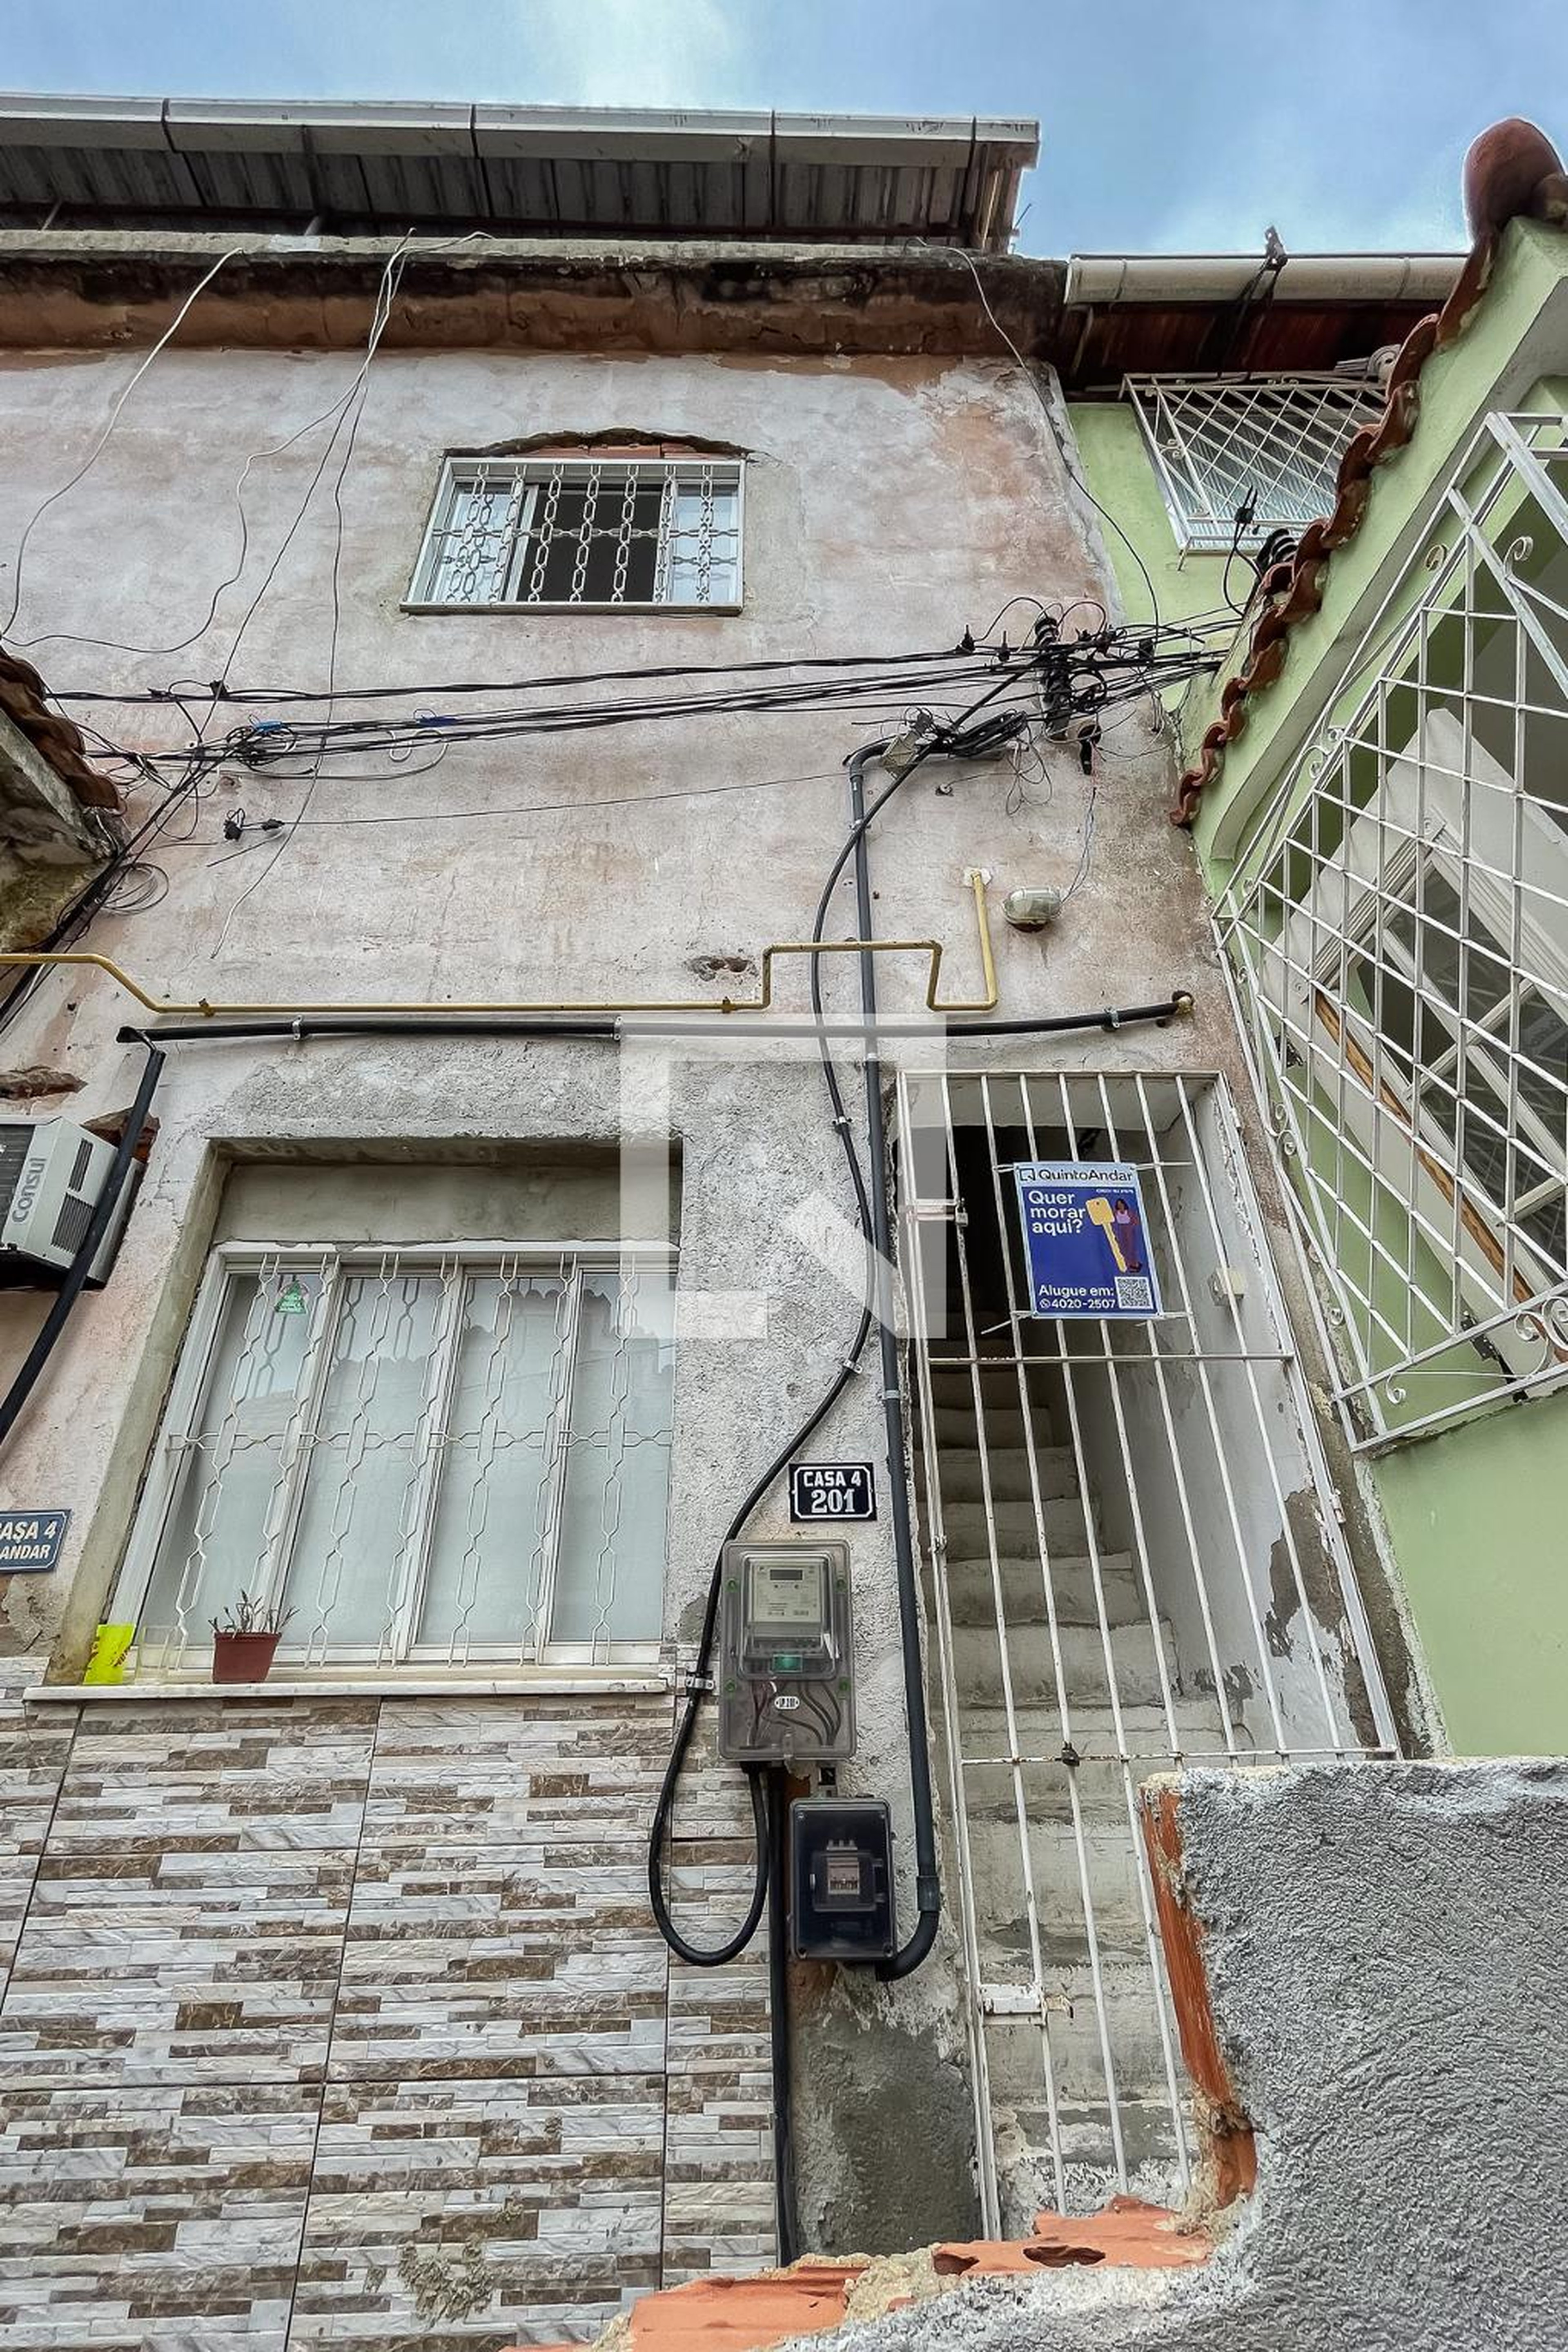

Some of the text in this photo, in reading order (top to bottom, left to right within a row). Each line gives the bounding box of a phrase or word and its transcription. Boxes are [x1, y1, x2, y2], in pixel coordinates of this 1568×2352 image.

[1039, 1169, 1133, 1181] QuintoAndar
[1028, 1190, 1075, 1204] Quer
[1030, 1207, 1086, 1218] morar
[1032, 1219, 1083, 1236] aqui?
[1039, 1285, 1114, 1298] Alugue em:
[1052, 1298, 1116, 1308] 4020-2507
[803, 1471, 861, 1487] CASA 4
[811, 1488, 855, 1513] 201
[0, 1521, 58, 1540] ASA 4
[0, 1544, 51, 1559] ANDAR
